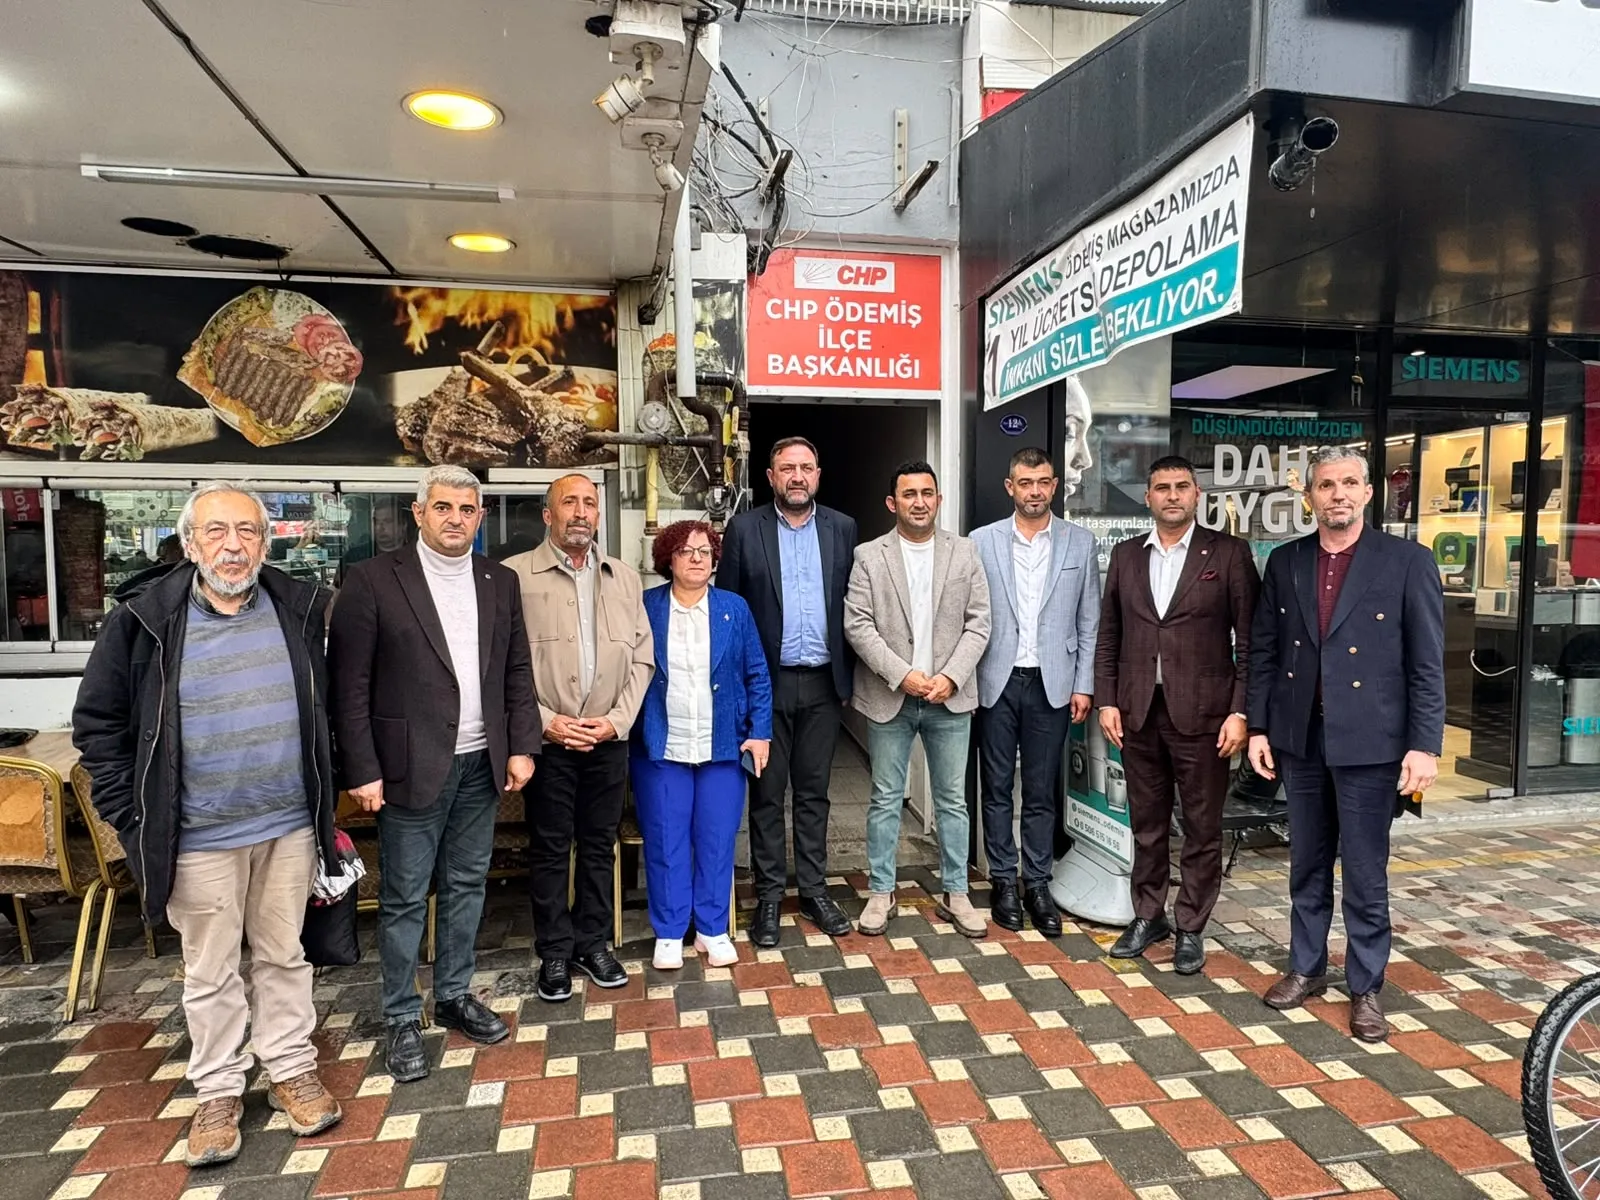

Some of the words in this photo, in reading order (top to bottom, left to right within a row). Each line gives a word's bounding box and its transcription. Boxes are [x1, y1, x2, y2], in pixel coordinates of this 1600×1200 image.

[988, 258, 1063, 329] SIEMENS
[1106, 154, 1241, 250] MAĞAZAMIZDA
[837, 265, 888, 287] CHP
[765, 298, 819, 321] CHP
[824, 296, 923, 329] ÖDEMİŞ
[986, 334, 1001, 397] 1
[1011, 323, 1029, 352] YIL
[1099, 199, 1239, 298] DEPOLAMA
[818, 324, 873, 353] İLÇE
[1003, 348, 1047, 392] İMKANI
[1050, 325, 1107, 371] SİZLE
[1105, 268, 1225, 344] BEKLİYOR.
[767, 353, 921, 379] BAŞKANLIĞI
[1401, 355, 1521, 383] SIEMENS
[1191, 414, 1364, 439] DÜŞÜNDÜĞÜNÜZDEN
[1213, 443, 1310, 487] DAH
